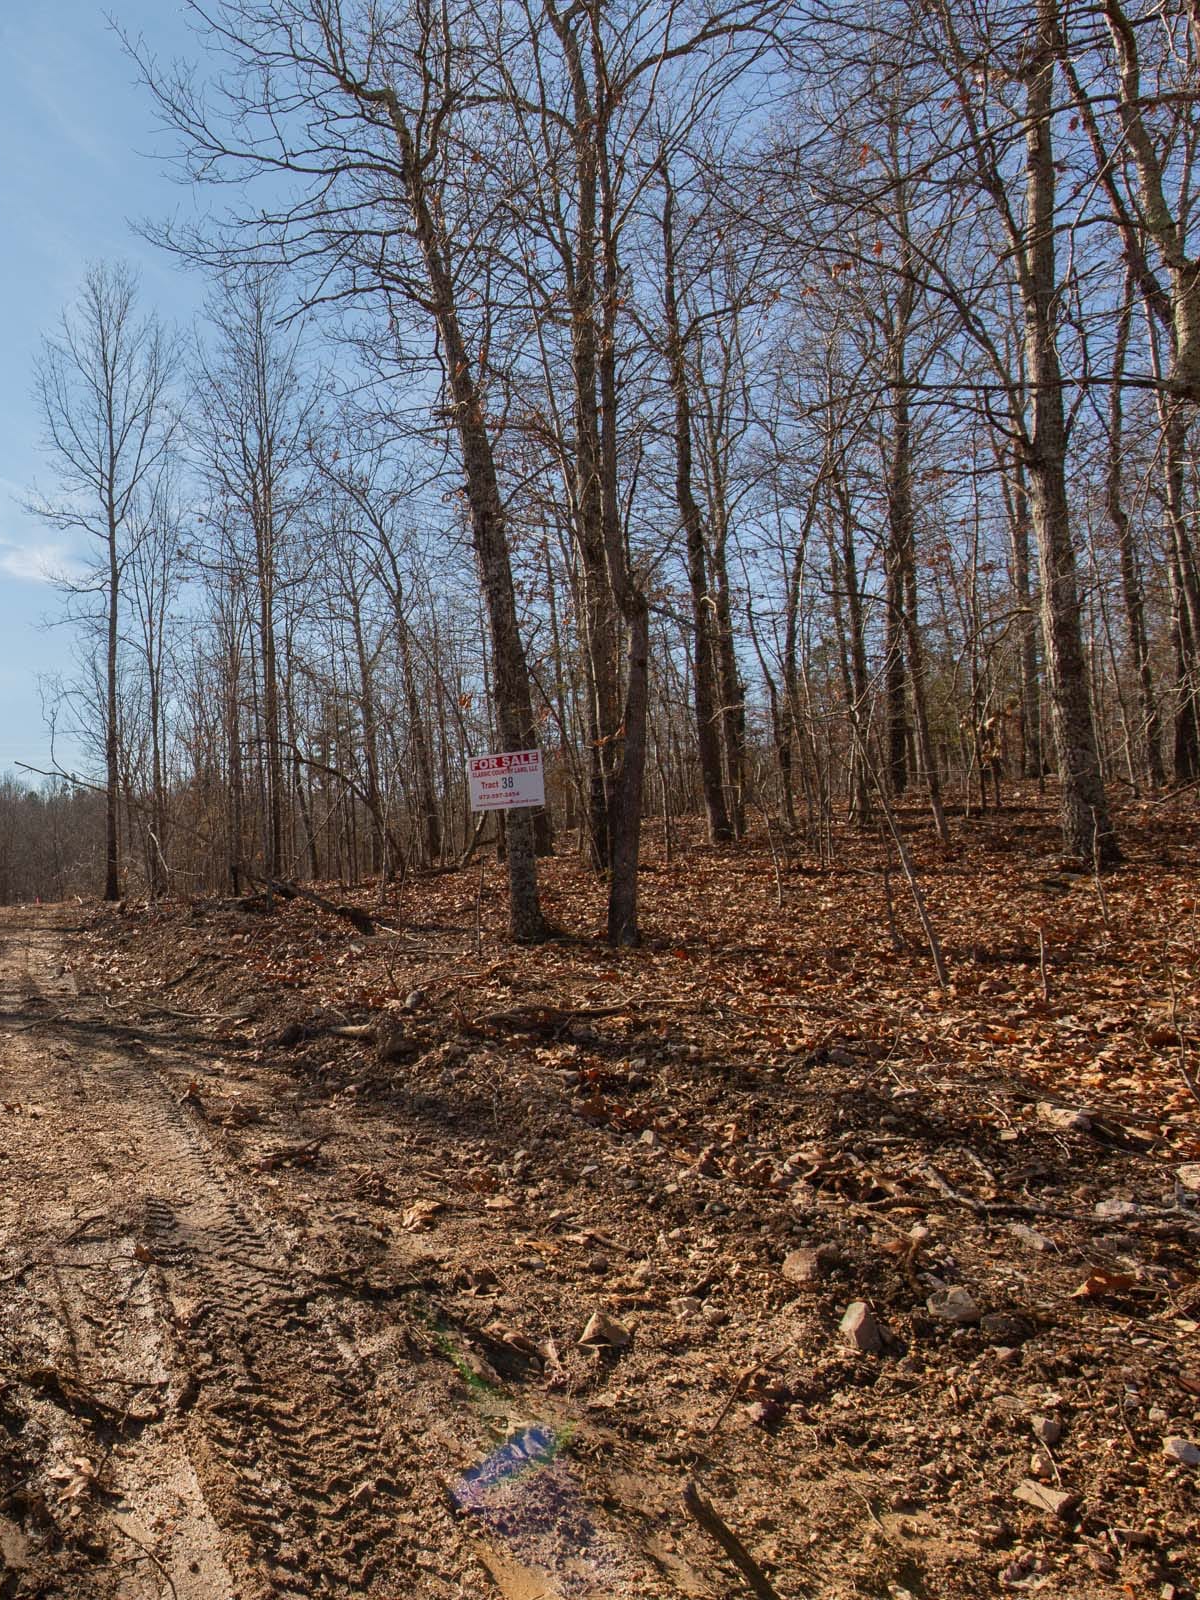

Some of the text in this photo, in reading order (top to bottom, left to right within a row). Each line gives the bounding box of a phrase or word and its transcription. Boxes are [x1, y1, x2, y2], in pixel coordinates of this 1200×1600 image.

[471, 753, 538, 771] FOR SALE
[481, 777, 514, 790] Tract 38
